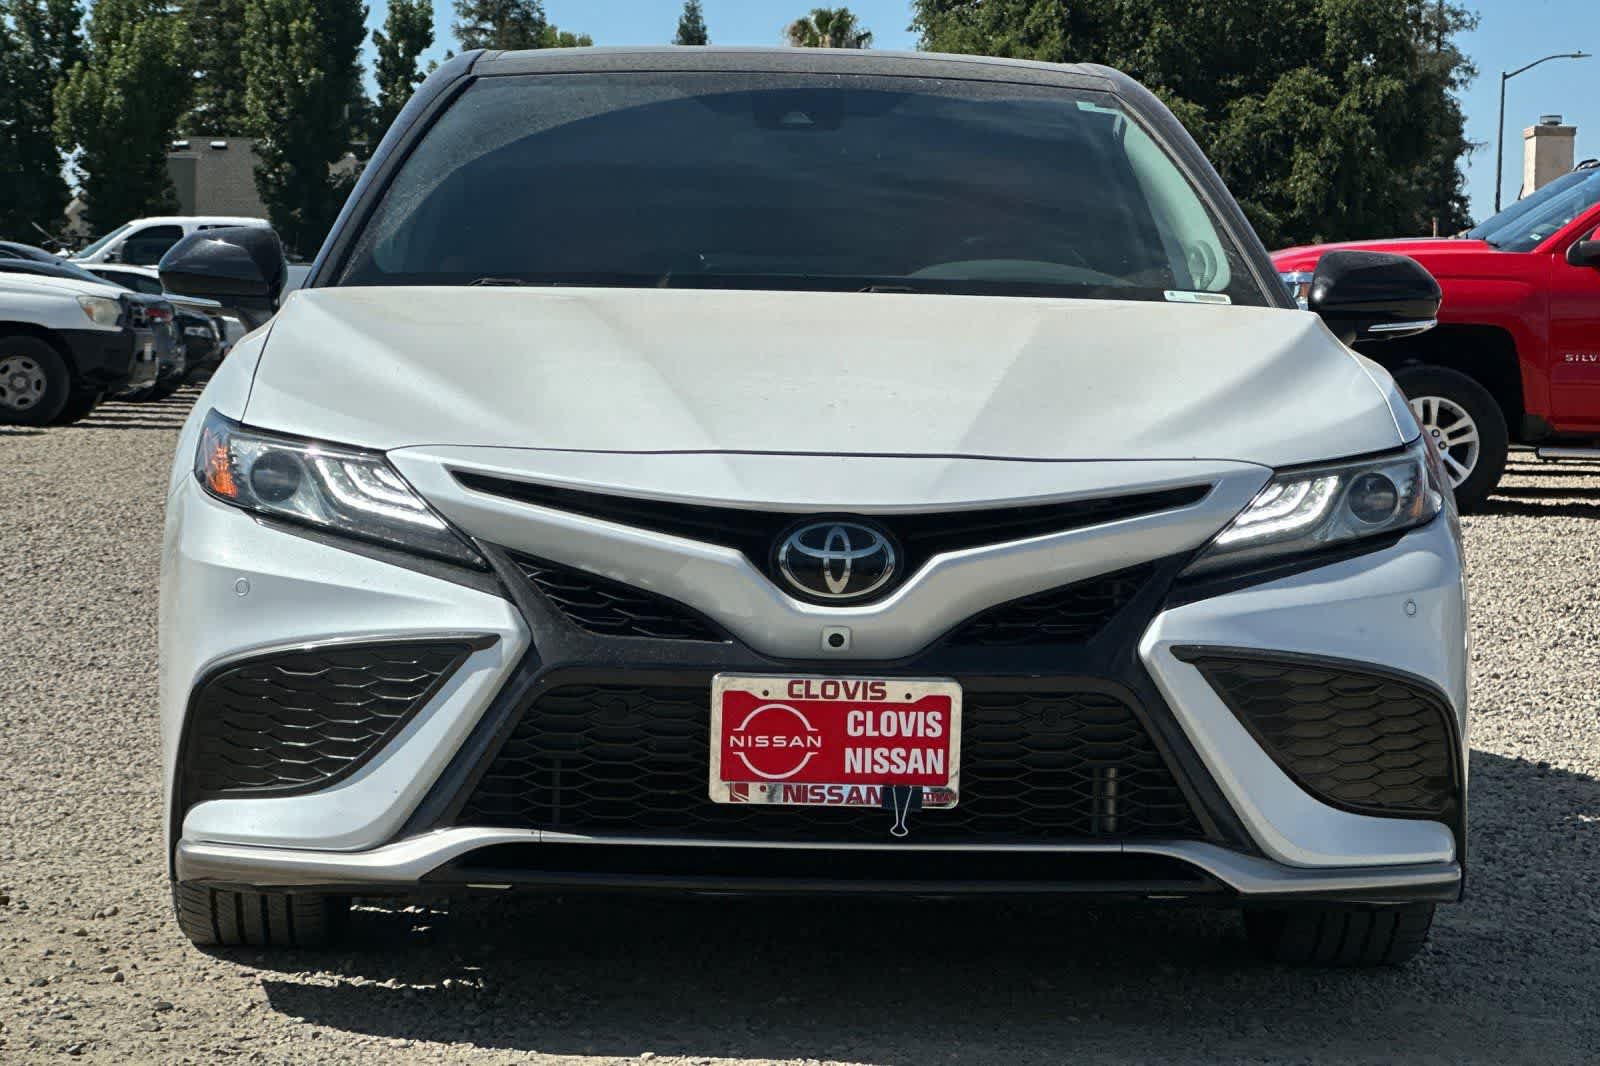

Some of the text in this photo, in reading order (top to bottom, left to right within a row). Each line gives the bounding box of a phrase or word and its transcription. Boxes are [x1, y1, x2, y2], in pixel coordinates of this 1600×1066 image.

[788, 680, 887, 701] CLOVIS
[847, 711, 943, 737] CLOVIS
[730, 736, 822, 748] NISSAN
[845, 748, 944, 774] NISSAN
[783, 785, 881, 805] NISSAN
